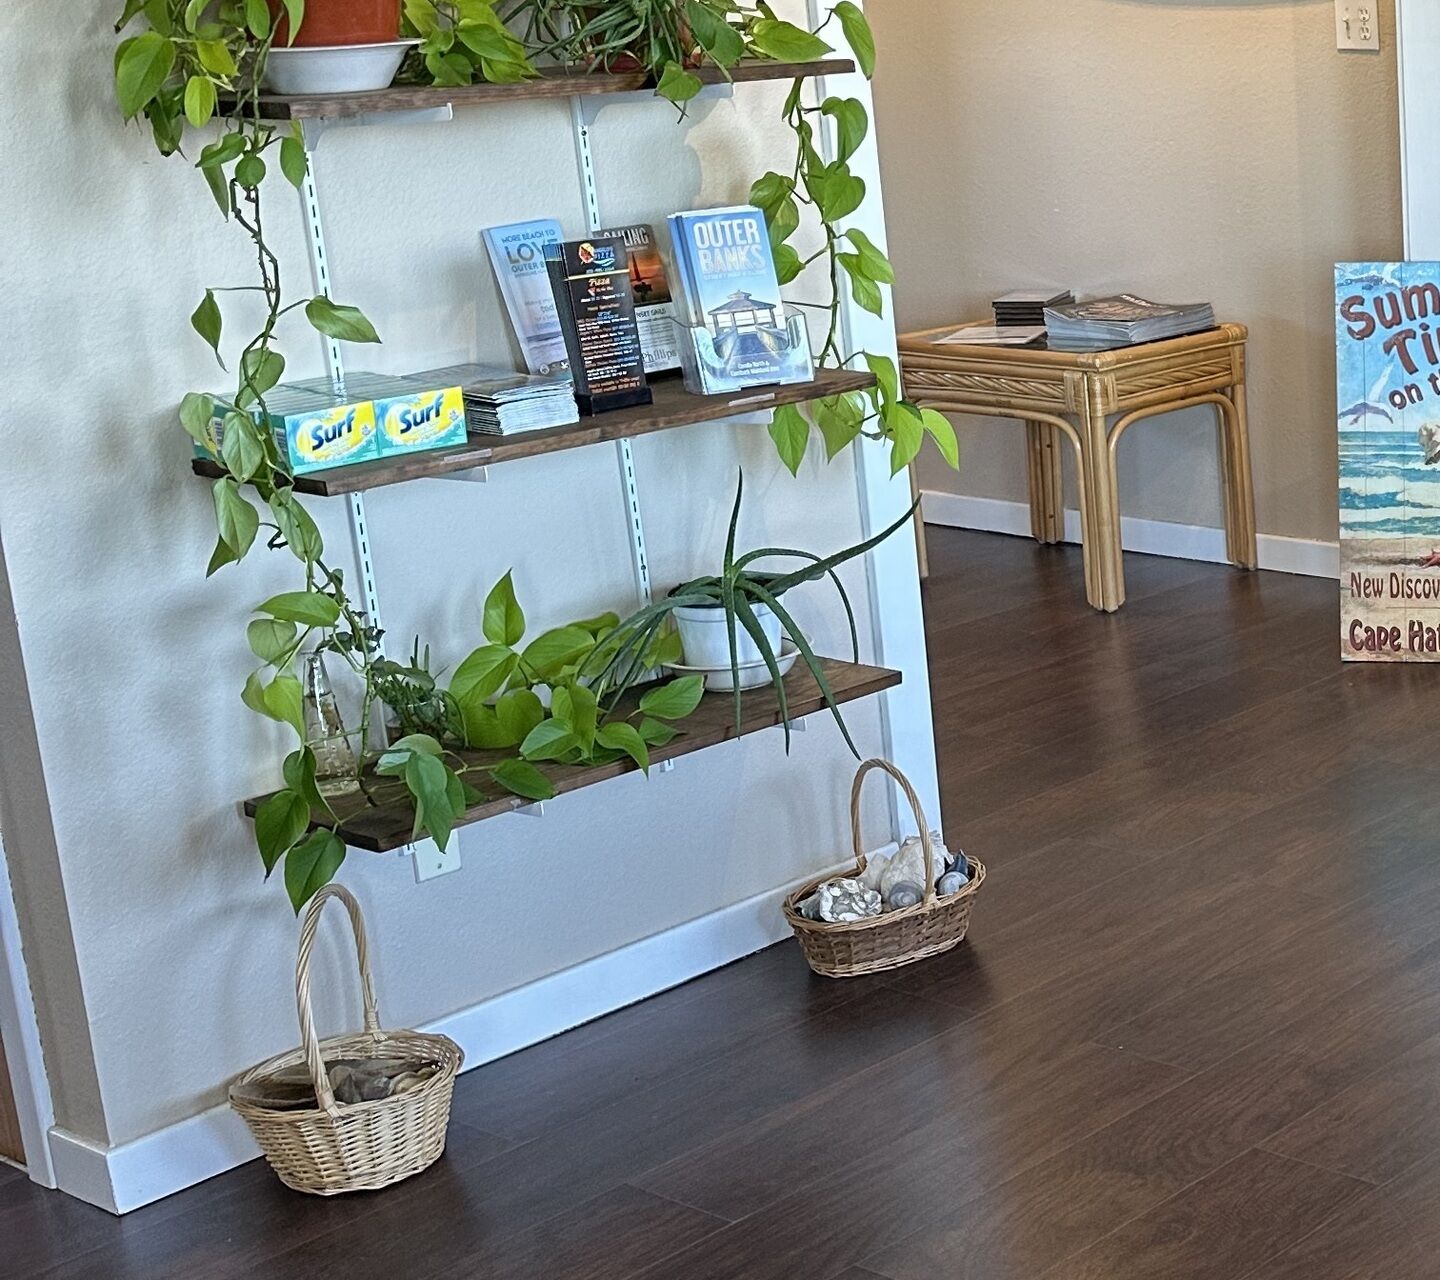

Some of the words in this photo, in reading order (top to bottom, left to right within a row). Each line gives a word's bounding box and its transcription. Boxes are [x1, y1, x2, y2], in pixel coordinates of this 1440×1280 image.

[501, 234, 521, 244] MORE
[522, 231, 545, 240] BEACH
[545, 228, 556, 236] TO
[693, 219, 760, 249] OUTER
[511, 262, 539, 273] OUTER
[697, 244, 767, 274] BANKS
[1388, 382, 1424, 410] on
[399, 393, 444, 434] Surf
[311, 408, 356, 451] Surf
[1350, 572, 1384, 599] New
[1349, 619, 1402, 652] Cape
